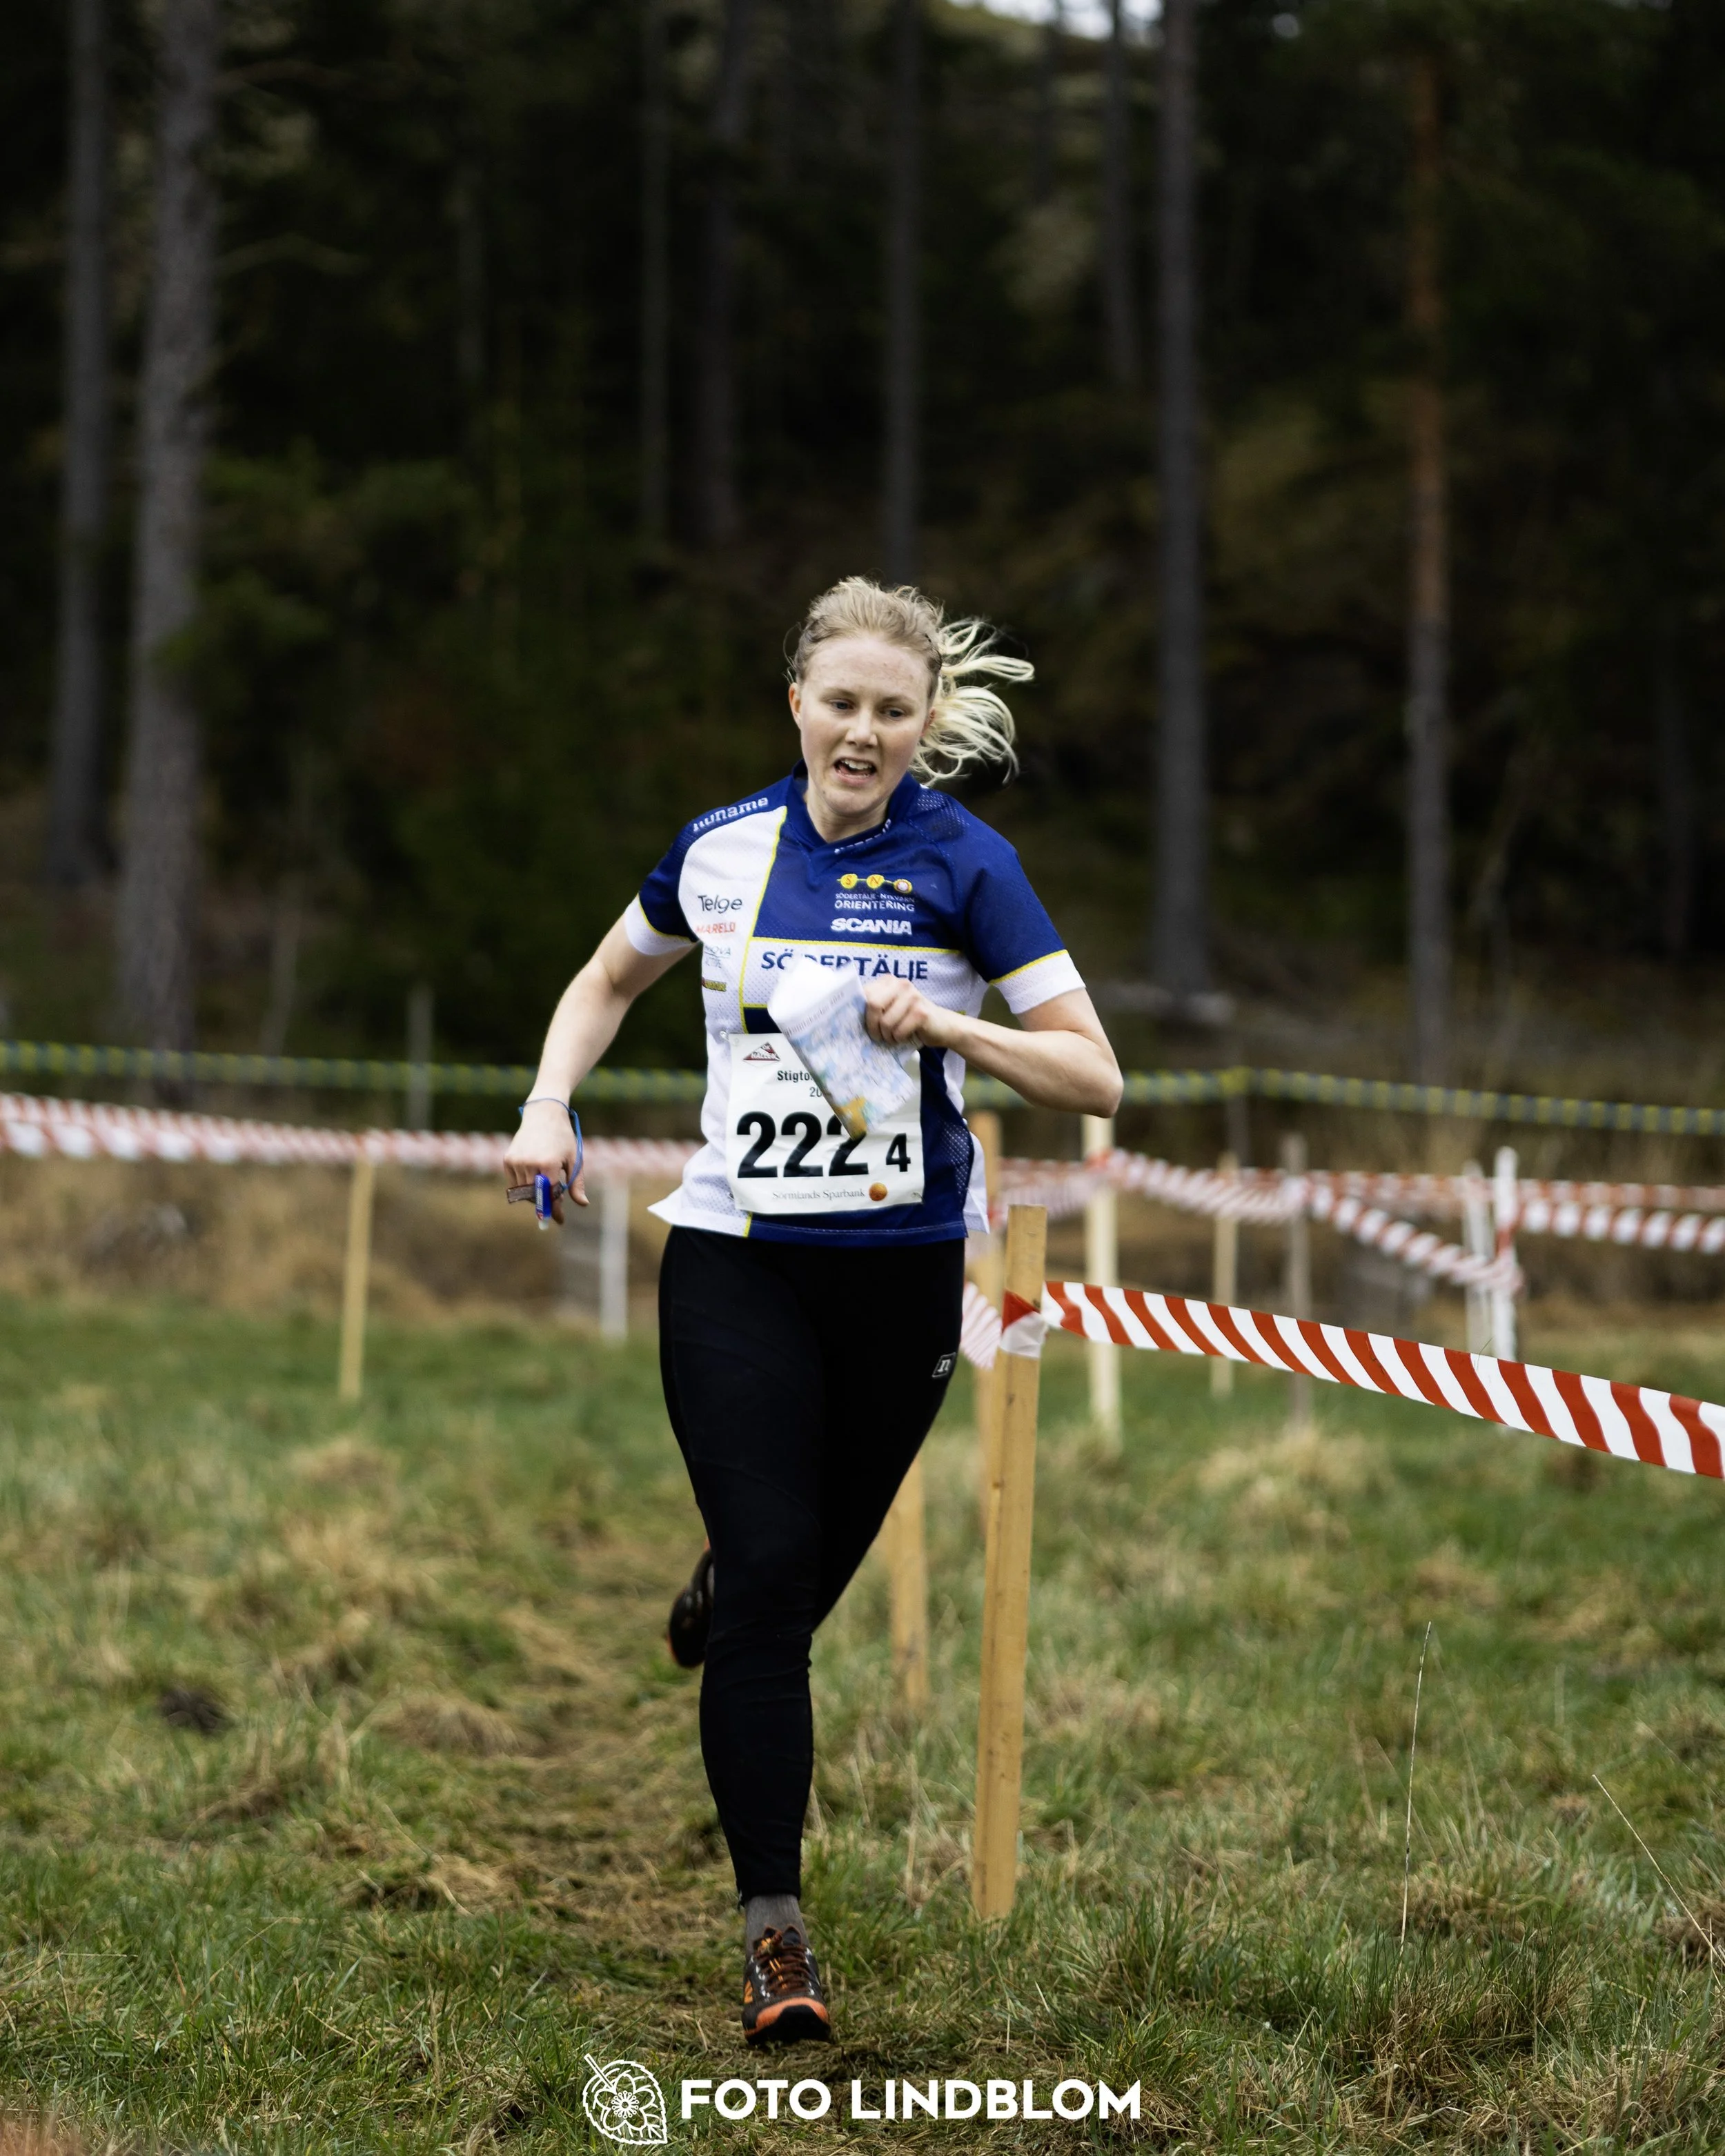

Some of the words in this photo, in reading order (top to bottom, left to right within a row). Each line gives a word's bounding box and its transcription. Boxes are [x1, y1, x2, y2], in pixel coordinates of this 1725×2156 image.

[698, 895, 742, 914] Telge
[834, 900, 915, 912] ORIENTERING
[830, 918, 912, 935] SCANIA
[777, 1070, 813, 1083] Stigto
[886, 1133, 911, 1172] 4
[822, 1188, 866, 1201] Sparbank
